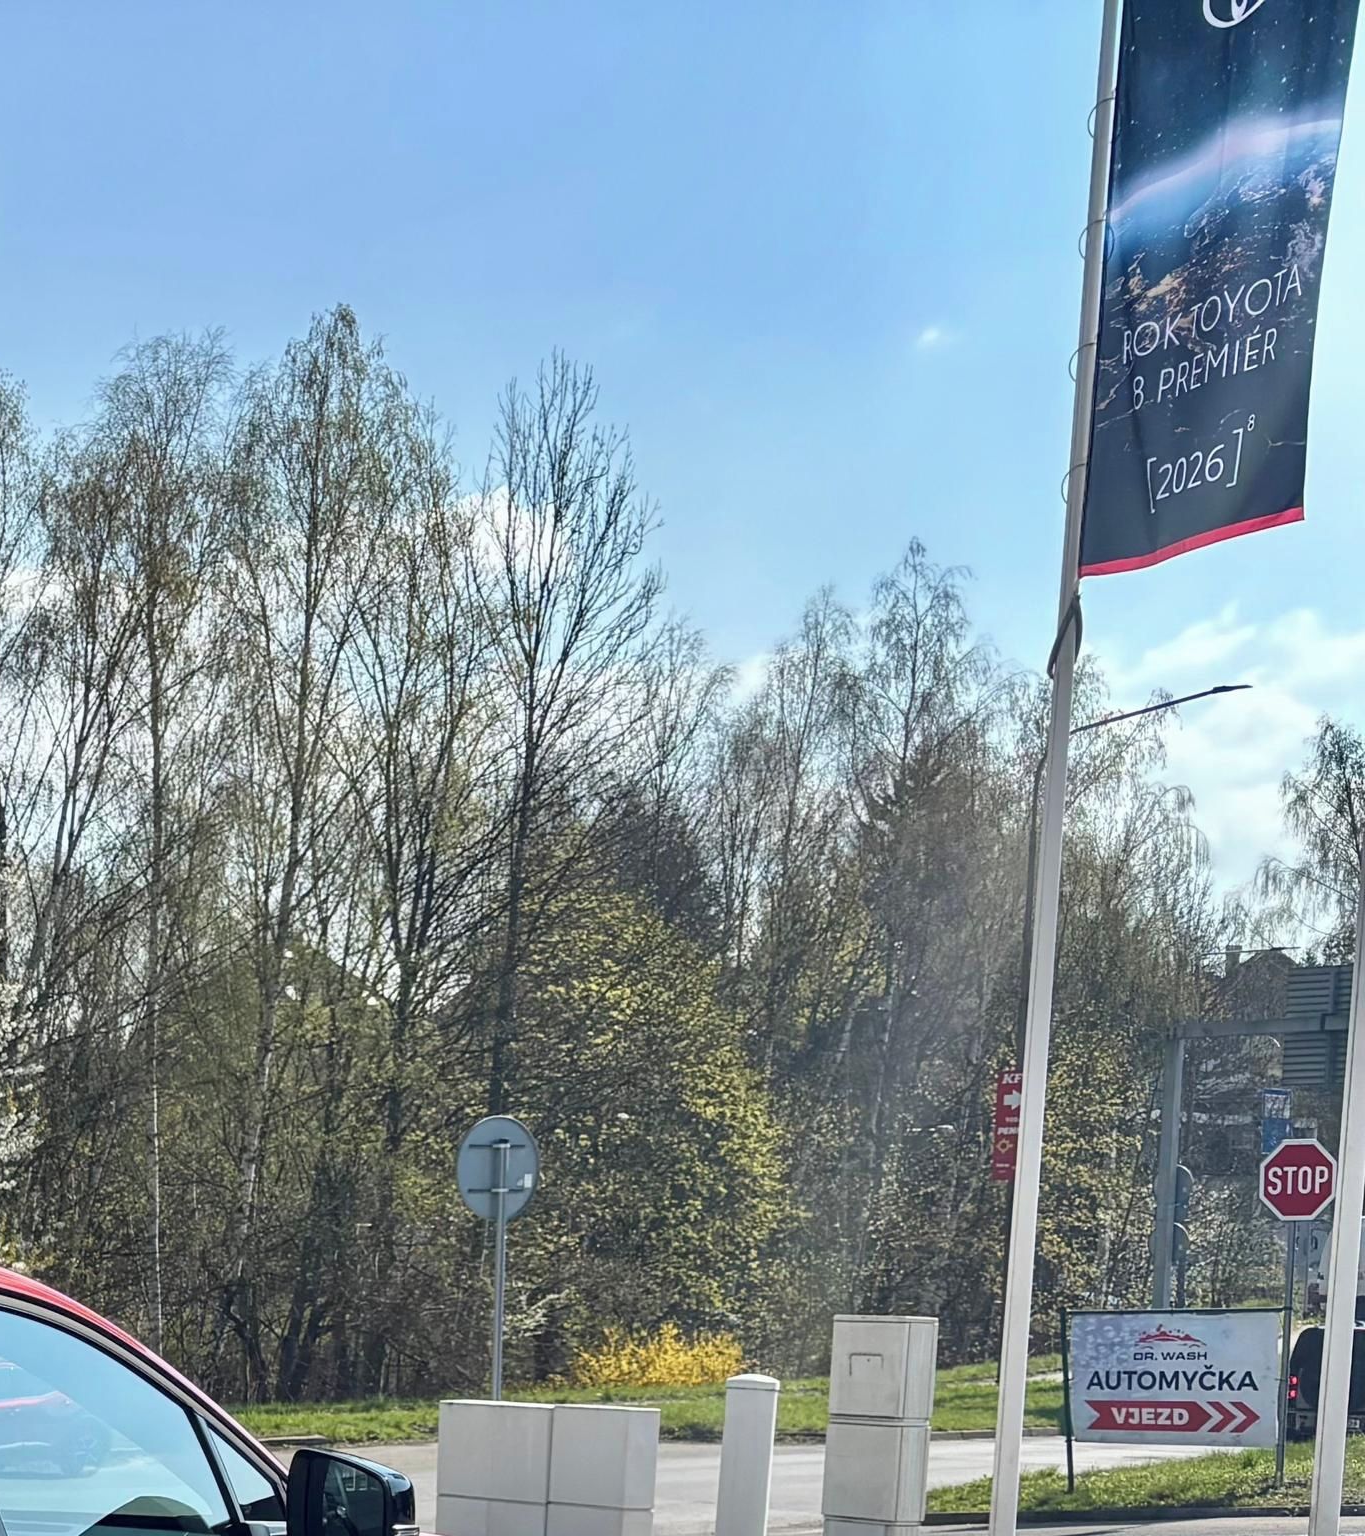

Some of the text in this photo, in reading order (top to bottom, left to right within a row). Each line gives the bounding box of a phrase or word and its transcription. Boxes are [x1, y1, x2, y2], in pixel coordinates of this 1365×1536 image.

[1123, 263, 1302, 364] ROK TOYOTA
[1133, 325, 1277, 410] 8 PREMIÉR
[1002, 1073, 1022, 1084] KF
[1267, 1166, 1329, 1196] STOP
[1133, 1352, 1207, 1361] DR. WASH
[1086, 1364, 1259, 1391] AUTOMYČKA
[1111, 1407, 1189, 1426] VJEZD
